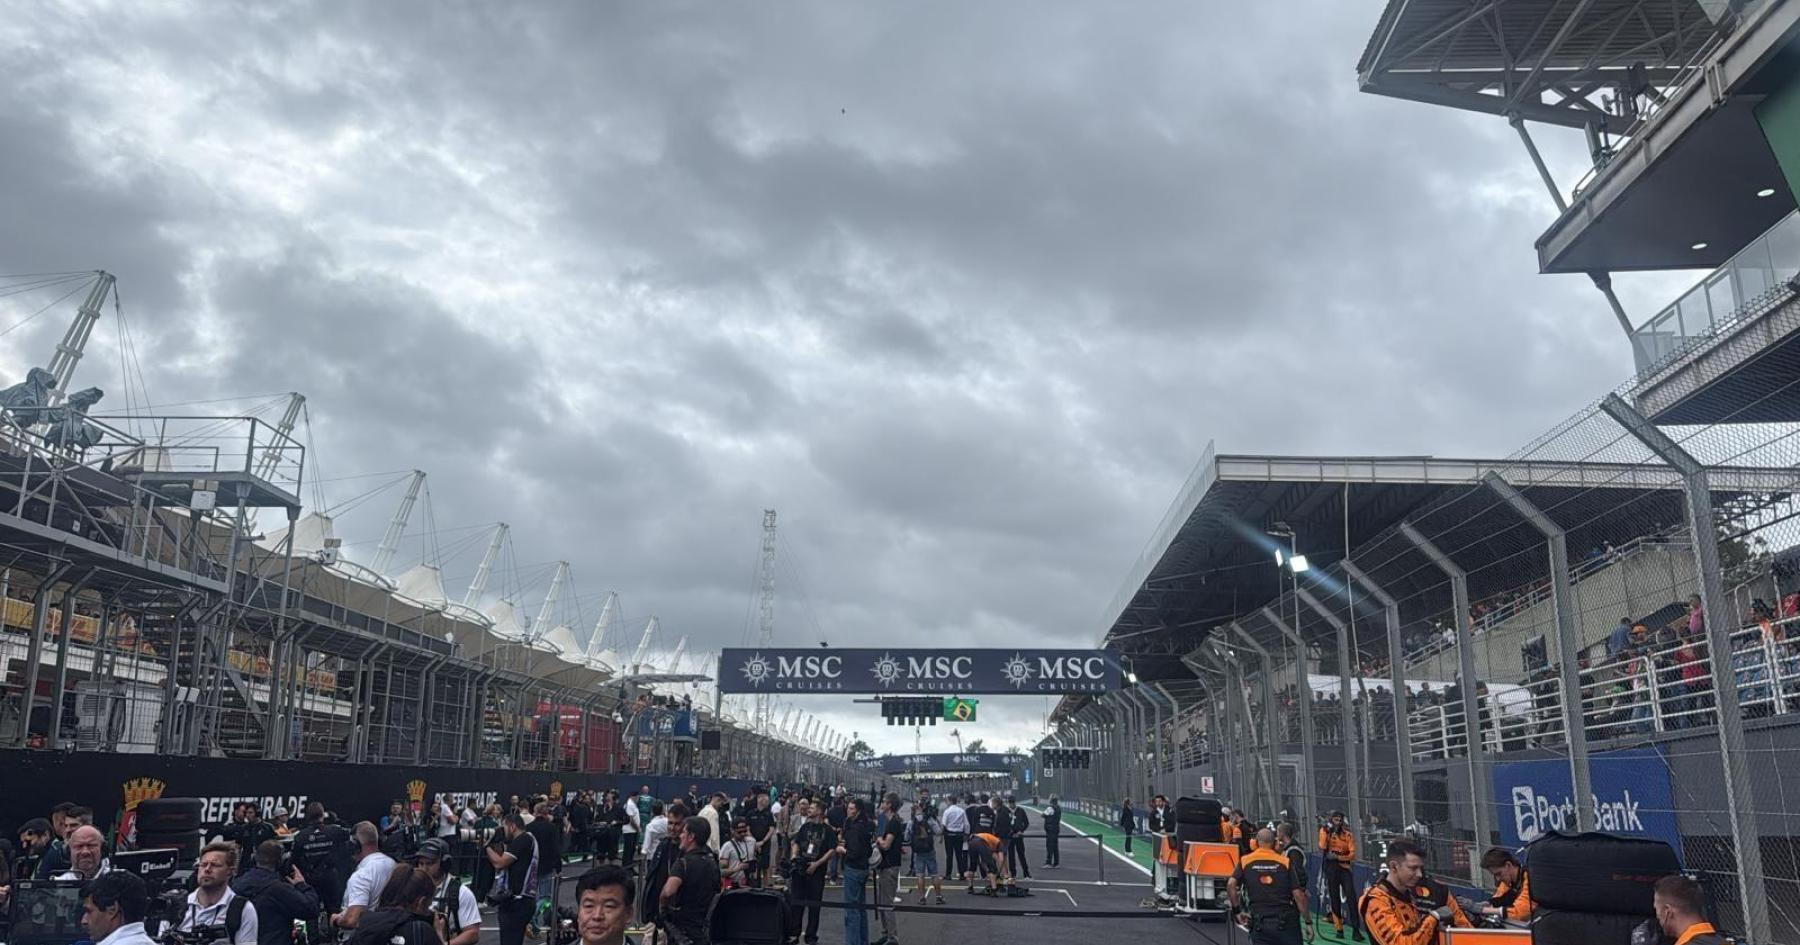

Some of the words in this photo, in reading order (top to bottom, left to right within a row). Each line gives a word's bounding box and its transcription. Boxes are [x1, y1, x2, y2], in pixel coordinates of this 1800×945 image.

[776, 656, 842, 678] MSC
[907, 656, 972, 678] MSC
[1038, 657, 1105, 679] MSC
[962, 755, 979, 763] MSC
